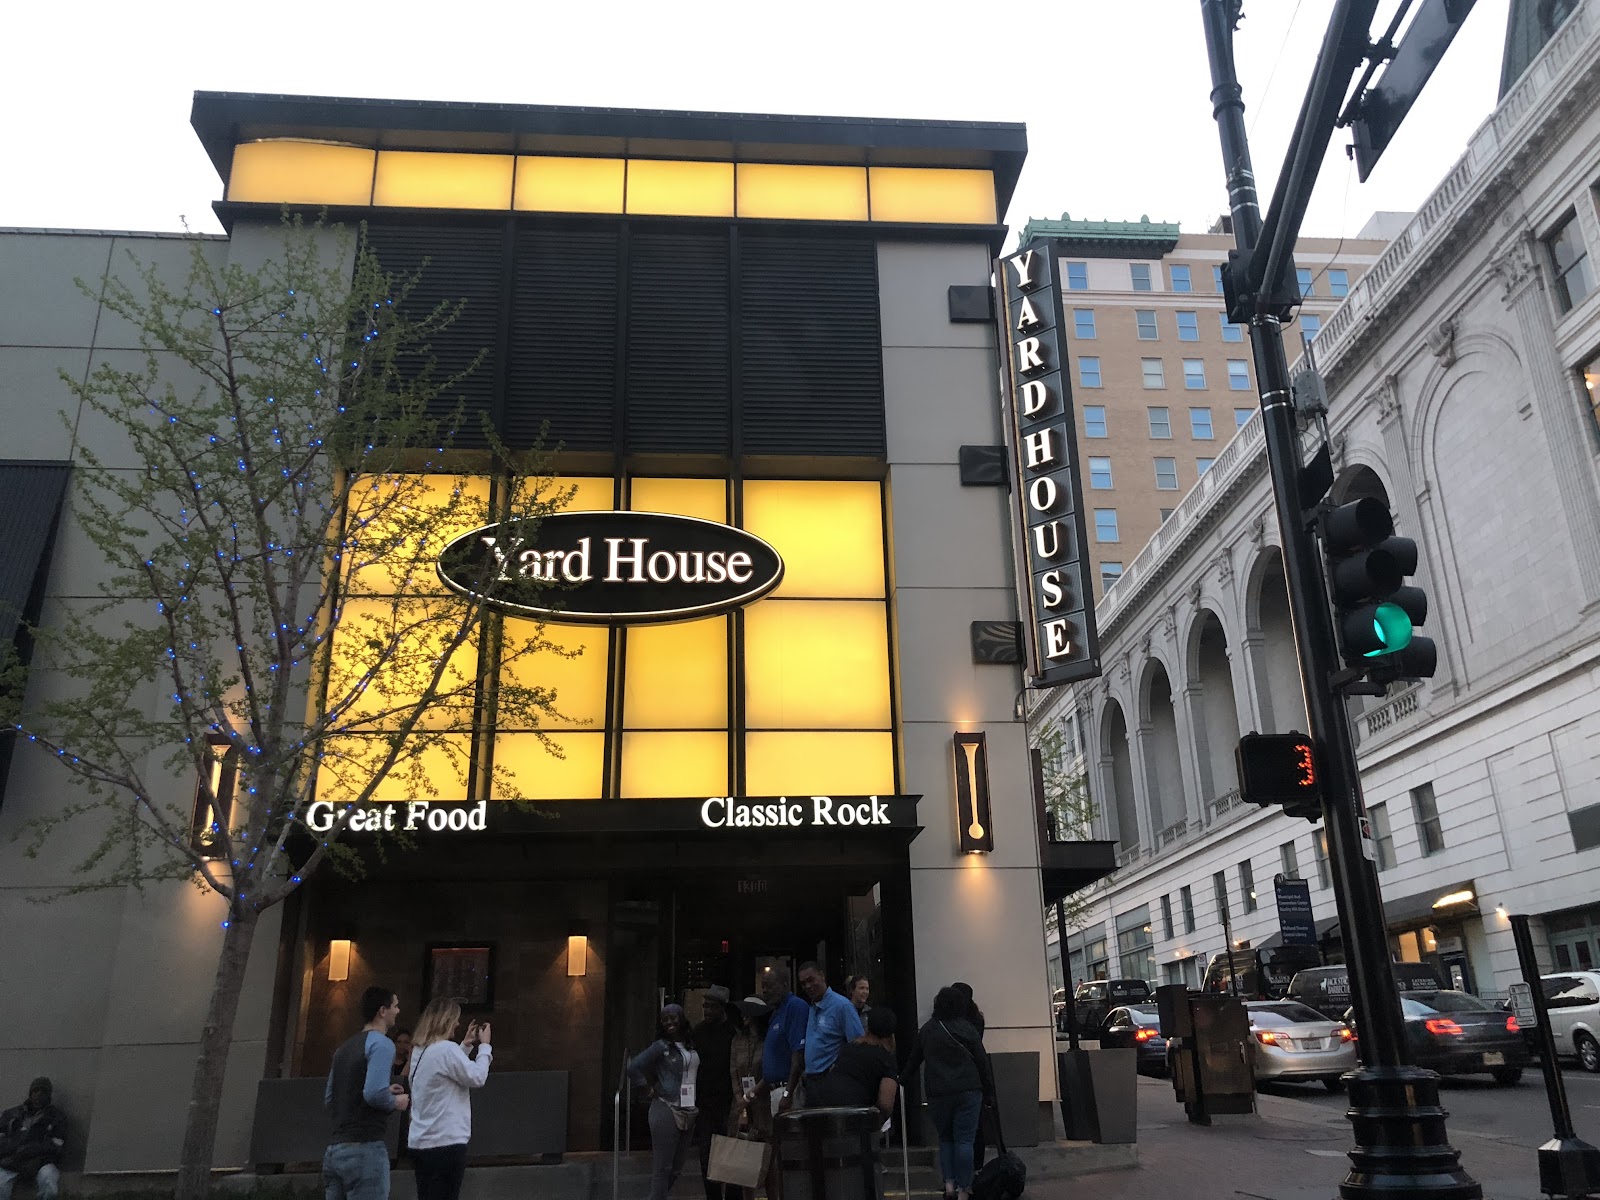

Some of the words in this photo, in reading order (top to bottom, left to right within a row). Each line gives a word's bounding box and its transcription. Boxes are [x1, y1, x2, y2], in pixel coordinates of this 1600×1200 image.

[1010, 250, 1047, 418] YARD
[601, 537, 754, 583] House
[1024, 428, 1071, 660] HOUSE
[403, 800, 488, 831] Food
[701, 797, 803, 827] Classic
[811, 795, 891, 826] Rock
